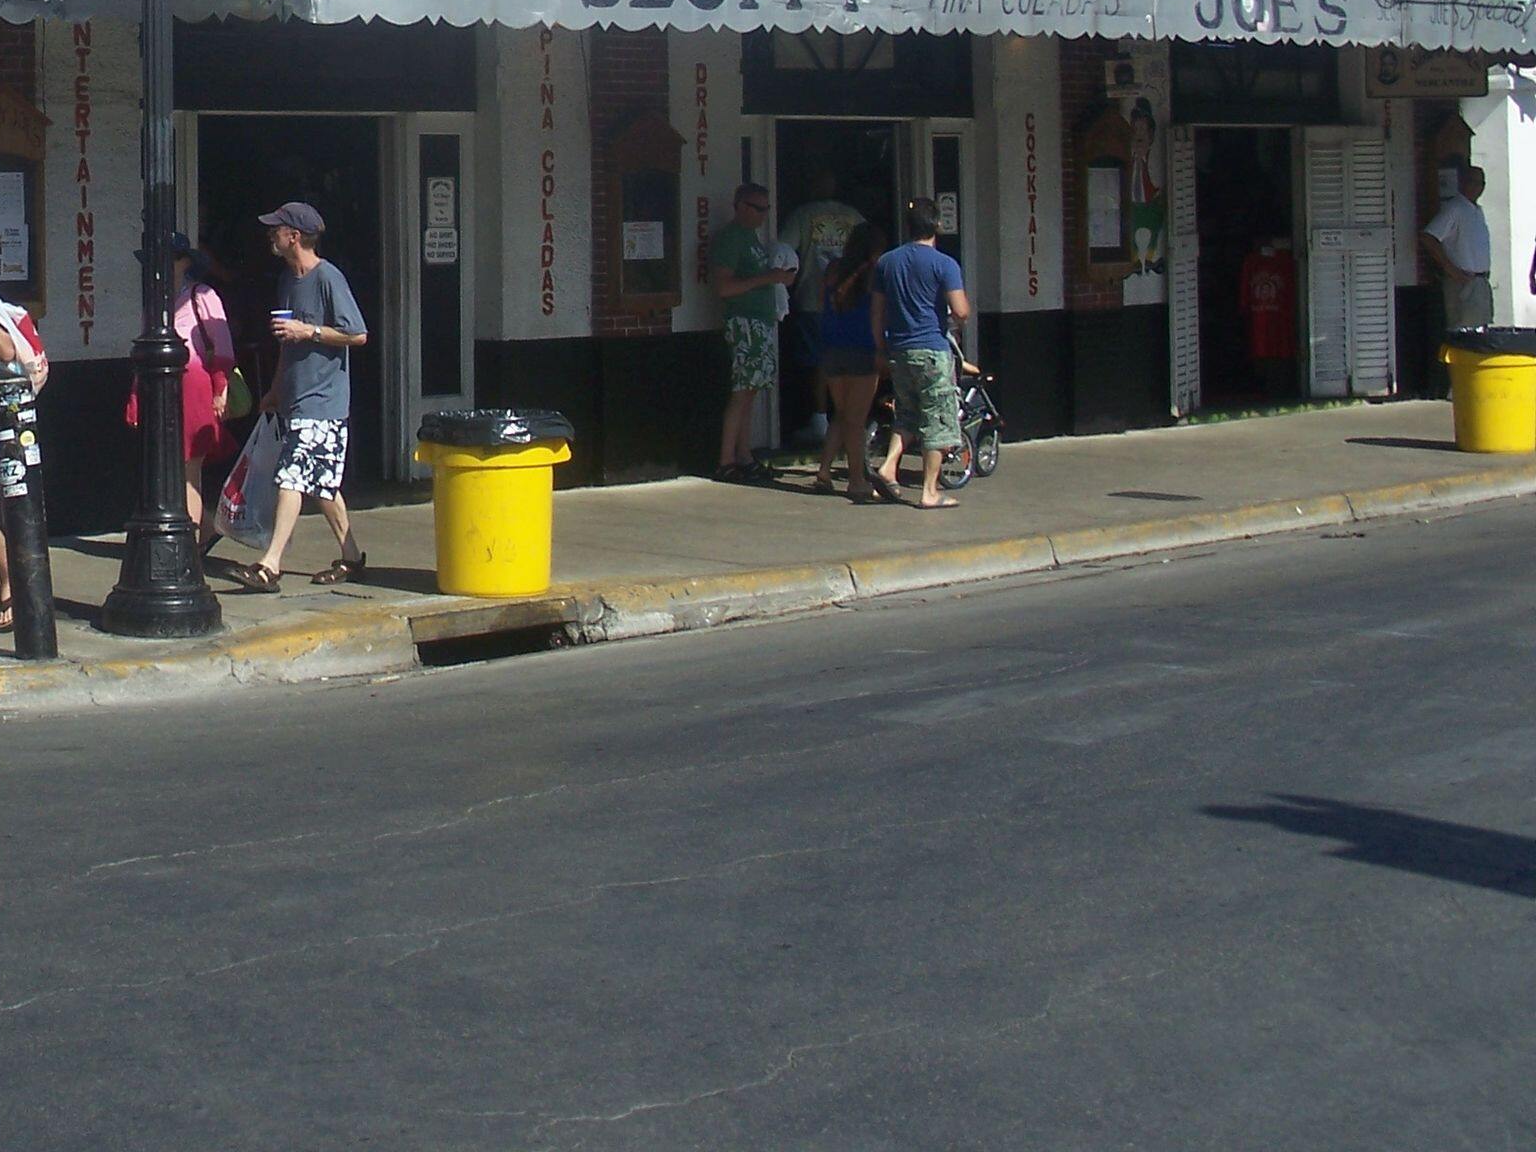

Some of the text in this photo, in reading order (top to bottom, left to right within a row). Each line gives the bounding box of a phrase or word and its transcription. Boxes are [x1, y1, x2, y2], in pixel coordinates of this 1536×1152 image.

[73, 21, 95, 346] NTERTAINMENT
[541, 149, 555, 316] COLADAS
[695, 62, 709, 285] DRAFT BEER
[1025, 112, 1038, 297] COCKTAILS
